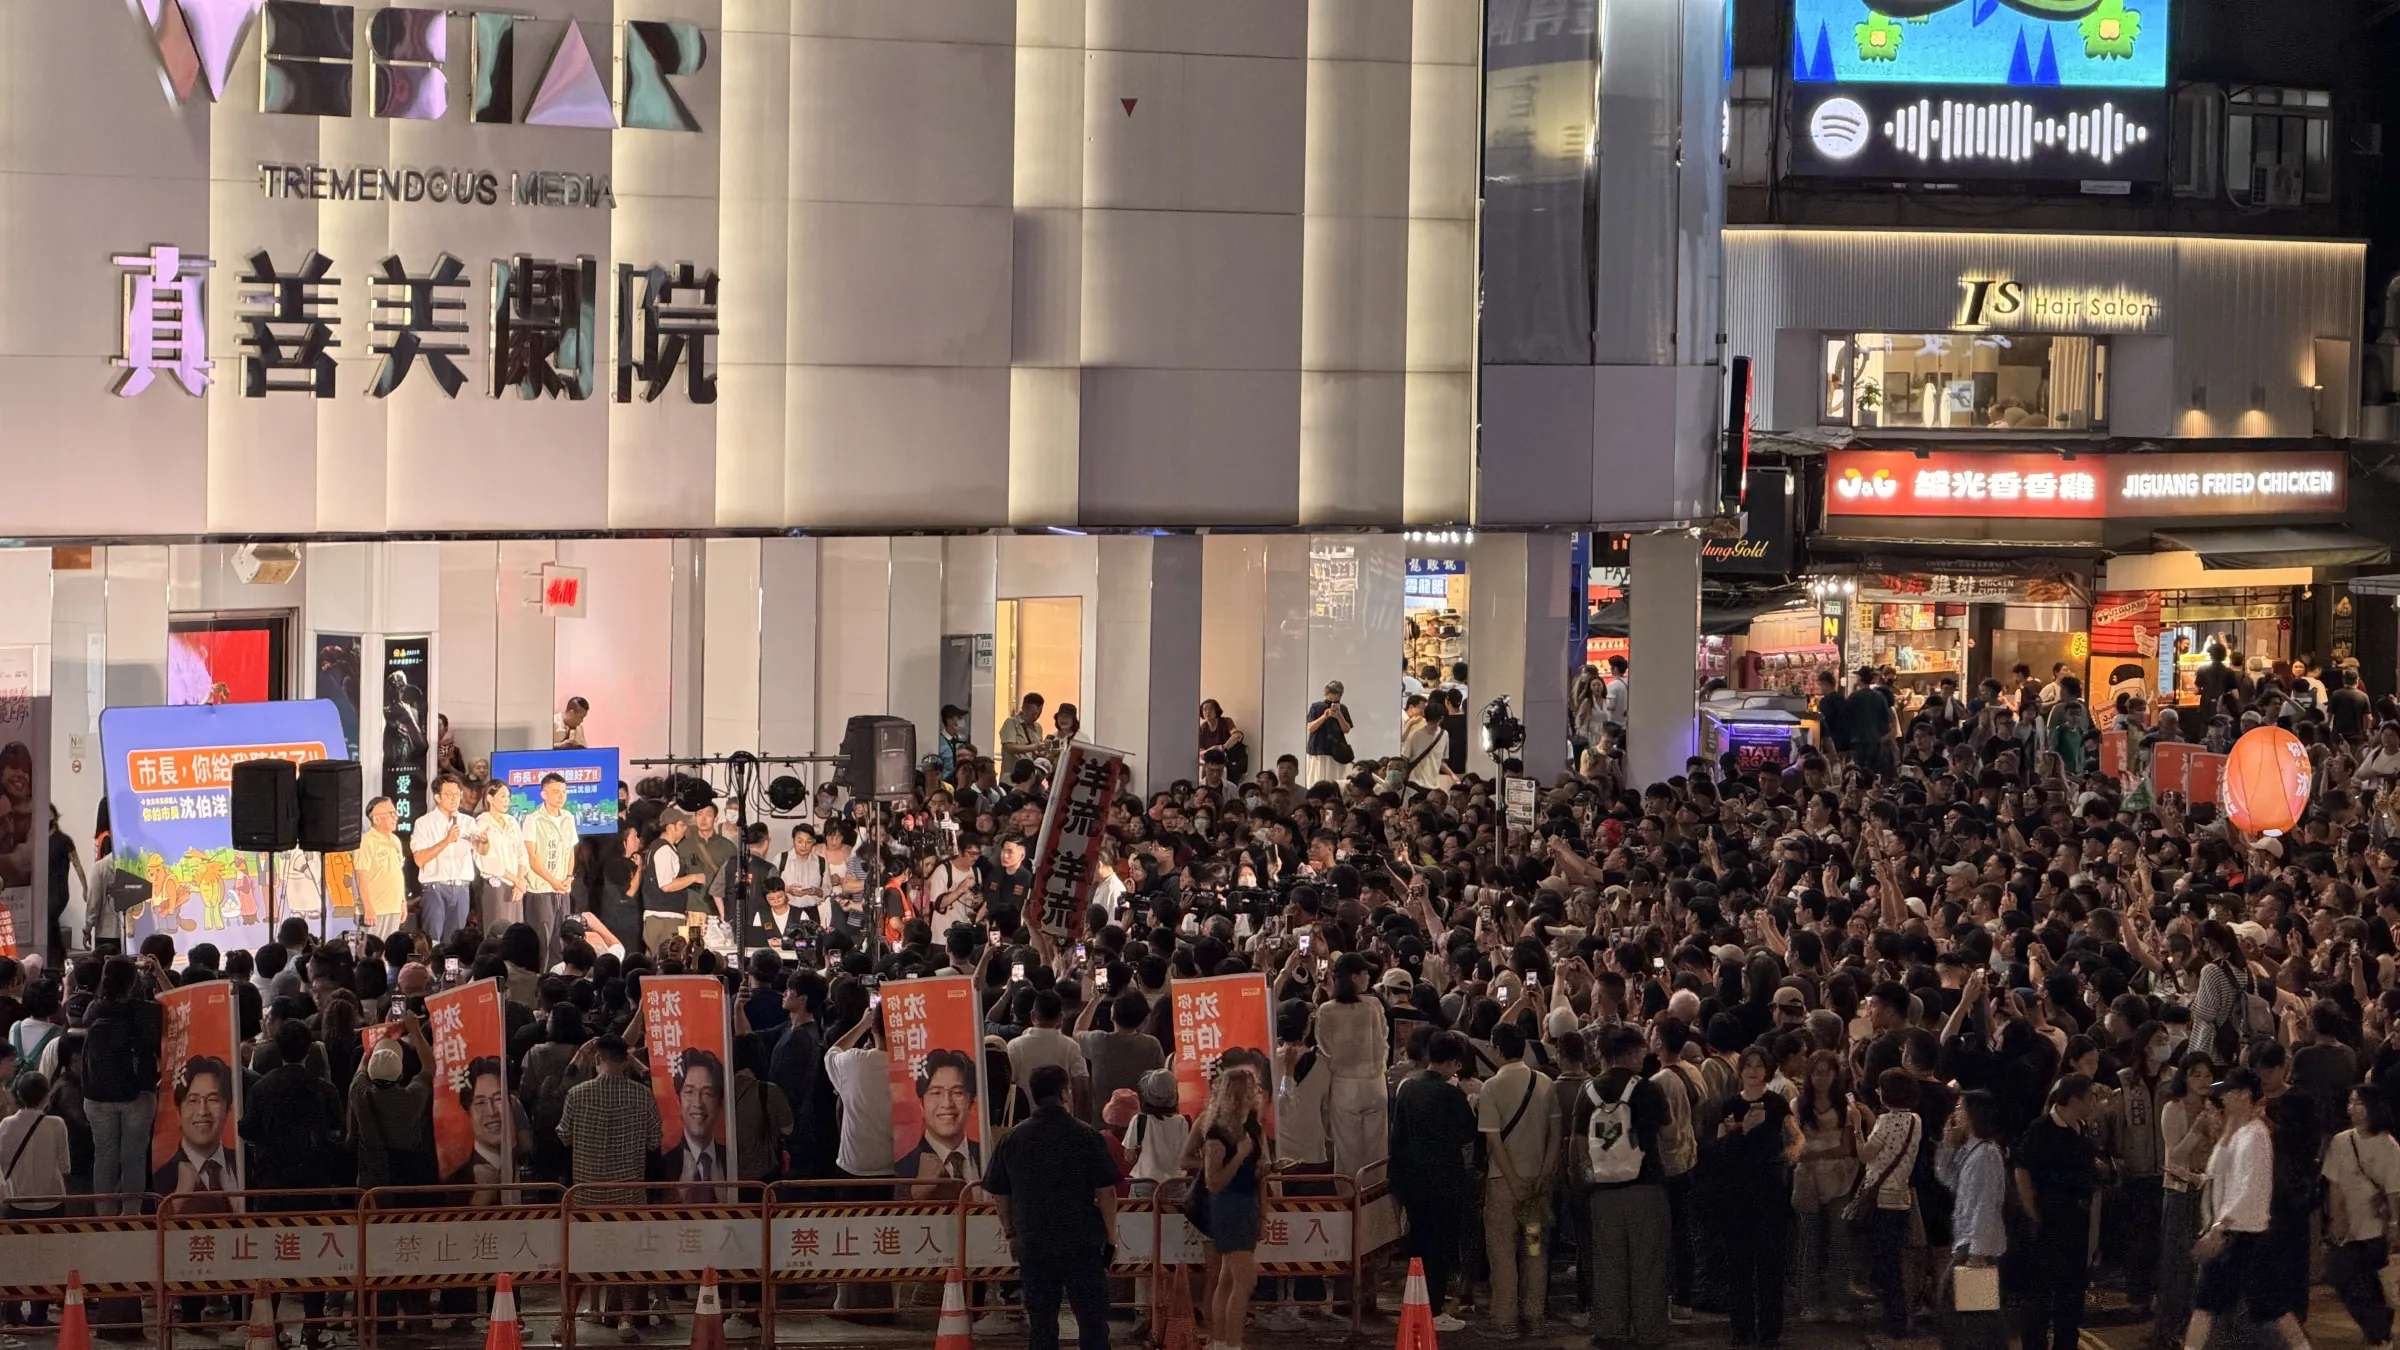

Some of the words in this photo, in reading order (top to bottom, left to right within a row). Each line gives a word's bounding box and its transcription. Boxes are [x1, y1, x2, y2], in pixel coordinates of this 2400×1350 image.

[257, 163, 498, 206] TREMENDOUS
[510, 170, 617, 208] MEDIA
[2034, 298, 2081, 316] Hair
[2091, 297, 2153, 316] Salon
[110, 242, 720, 404] 真善美劇院
[2121, 474, 2198, 497] JIGUANG
[2202, 472, 2255, 495] FRIED
[2257, 470, 2333, 494] CHICKEN
[1979, 579, 2014, 588] CHICKEN
[1739, 745, 1780, 757] STATE
[143, 806, 180, 822] 你的市長
[180, 794, 228, 819] 沈伯洋
[189, 1231, 344, 1262] 禁止進入
[394, 1231, 538, 1263] 禁止進入
[791, 1226, 942, 1257] 禁止進入
